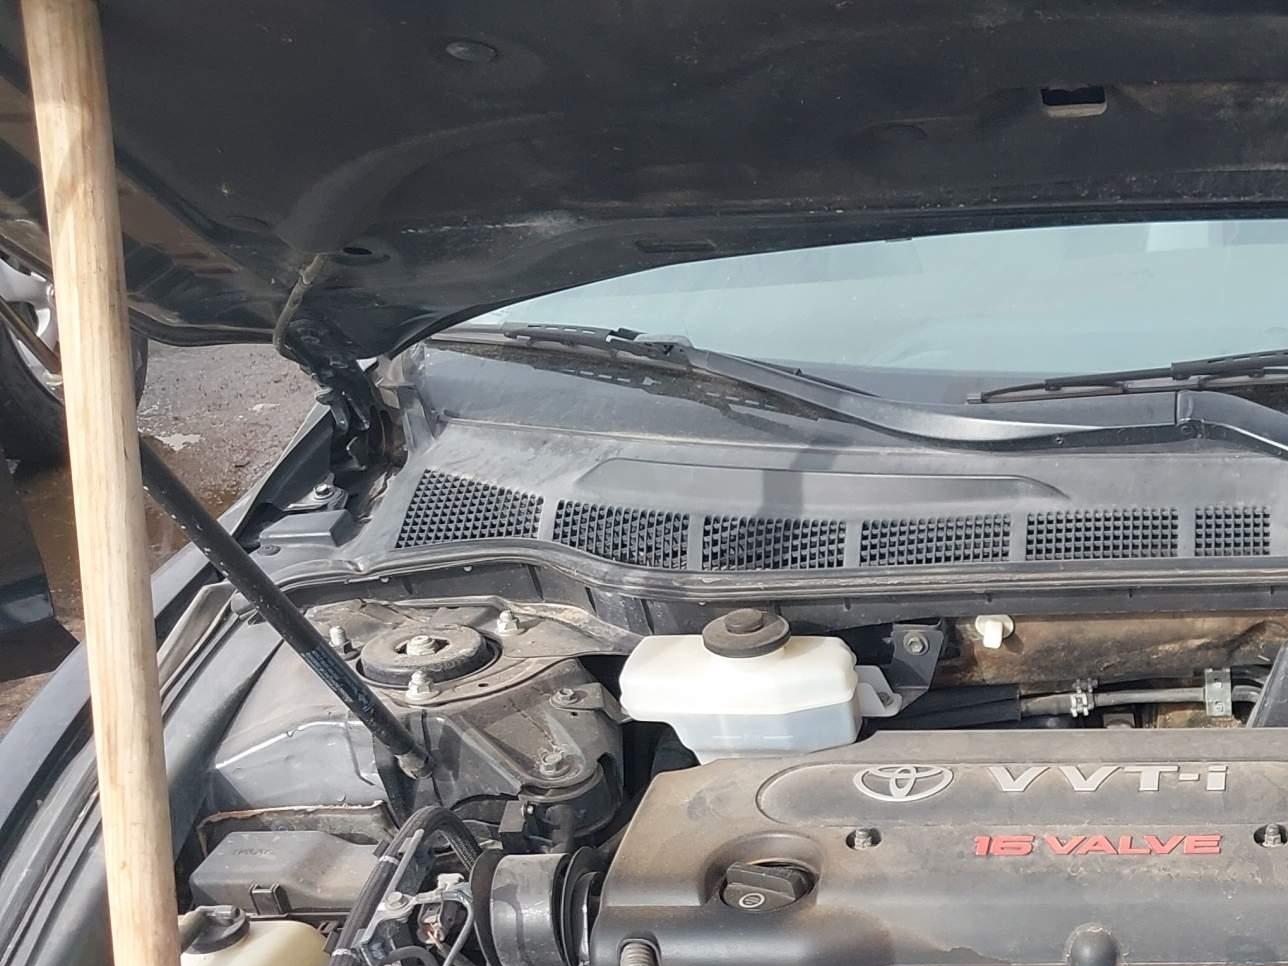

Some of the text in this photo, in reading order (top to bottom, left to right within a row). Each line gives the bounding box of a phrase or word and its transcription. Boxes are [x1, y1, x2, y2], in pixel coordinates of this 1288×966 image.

[987, 765, 1228, 792] VVT-i
[974, 834, 1222, 857] 16 VALVE
